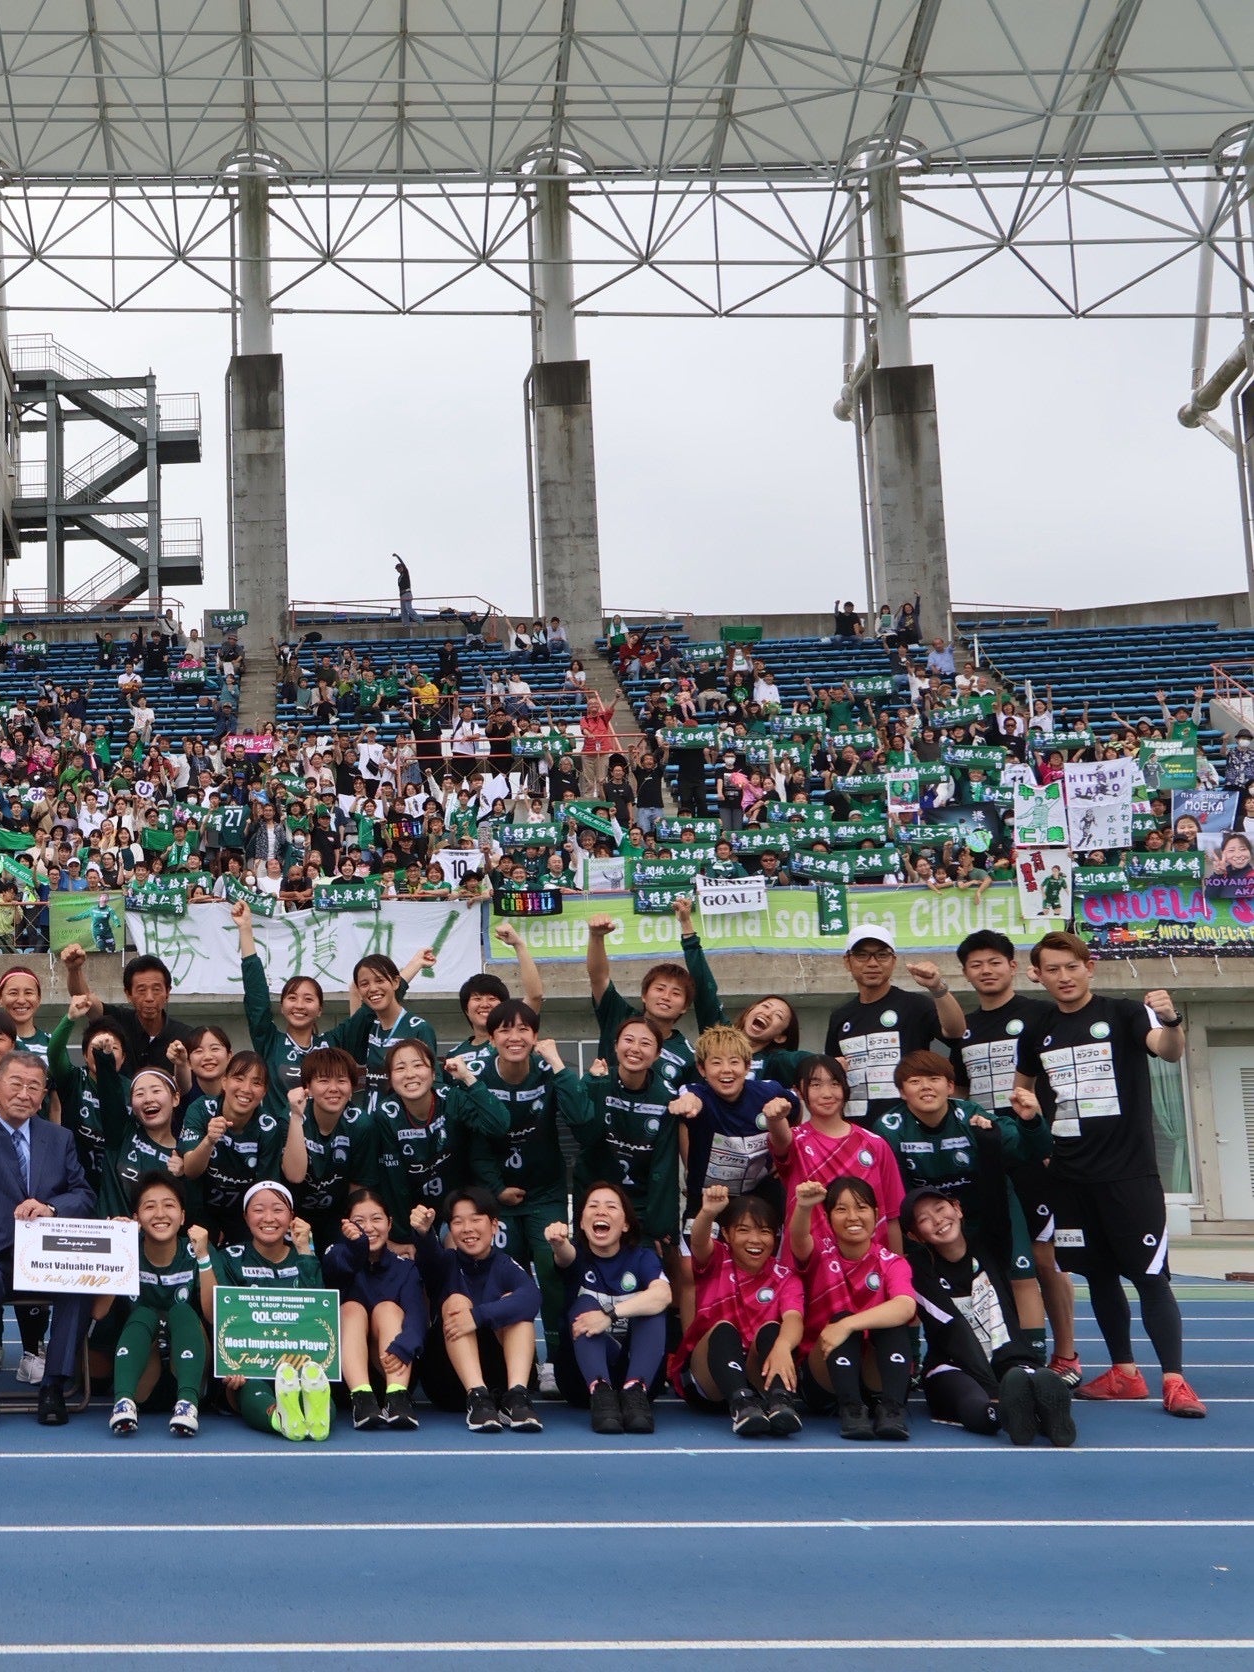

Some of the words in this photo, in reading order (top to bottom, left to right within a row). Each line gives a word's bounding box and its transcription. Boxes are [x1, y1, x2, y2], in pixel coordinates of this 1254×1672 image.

[1184, 801, 1225, 813] MOEKA
[225, 809, 243, 827] 27
[1084, 887, 1212, 922] CIRUELA
[31, 1260, 53, 1269] Most
[55, 1261, 94, 1271] Valuable
[96, 1264, 125, 1273] Player
[74, 1274, 110, 1288] MVP
[252, 1311, 272, 1323] QOL
[272, 1312, 299, 1322] GROUP
[225, 1337, 247, 1349] Most
[248, 1338, 299, 1350] Impressive
[299, 1340, 329, 1352] Player
[238, 1353, 275, 1368] Today's
